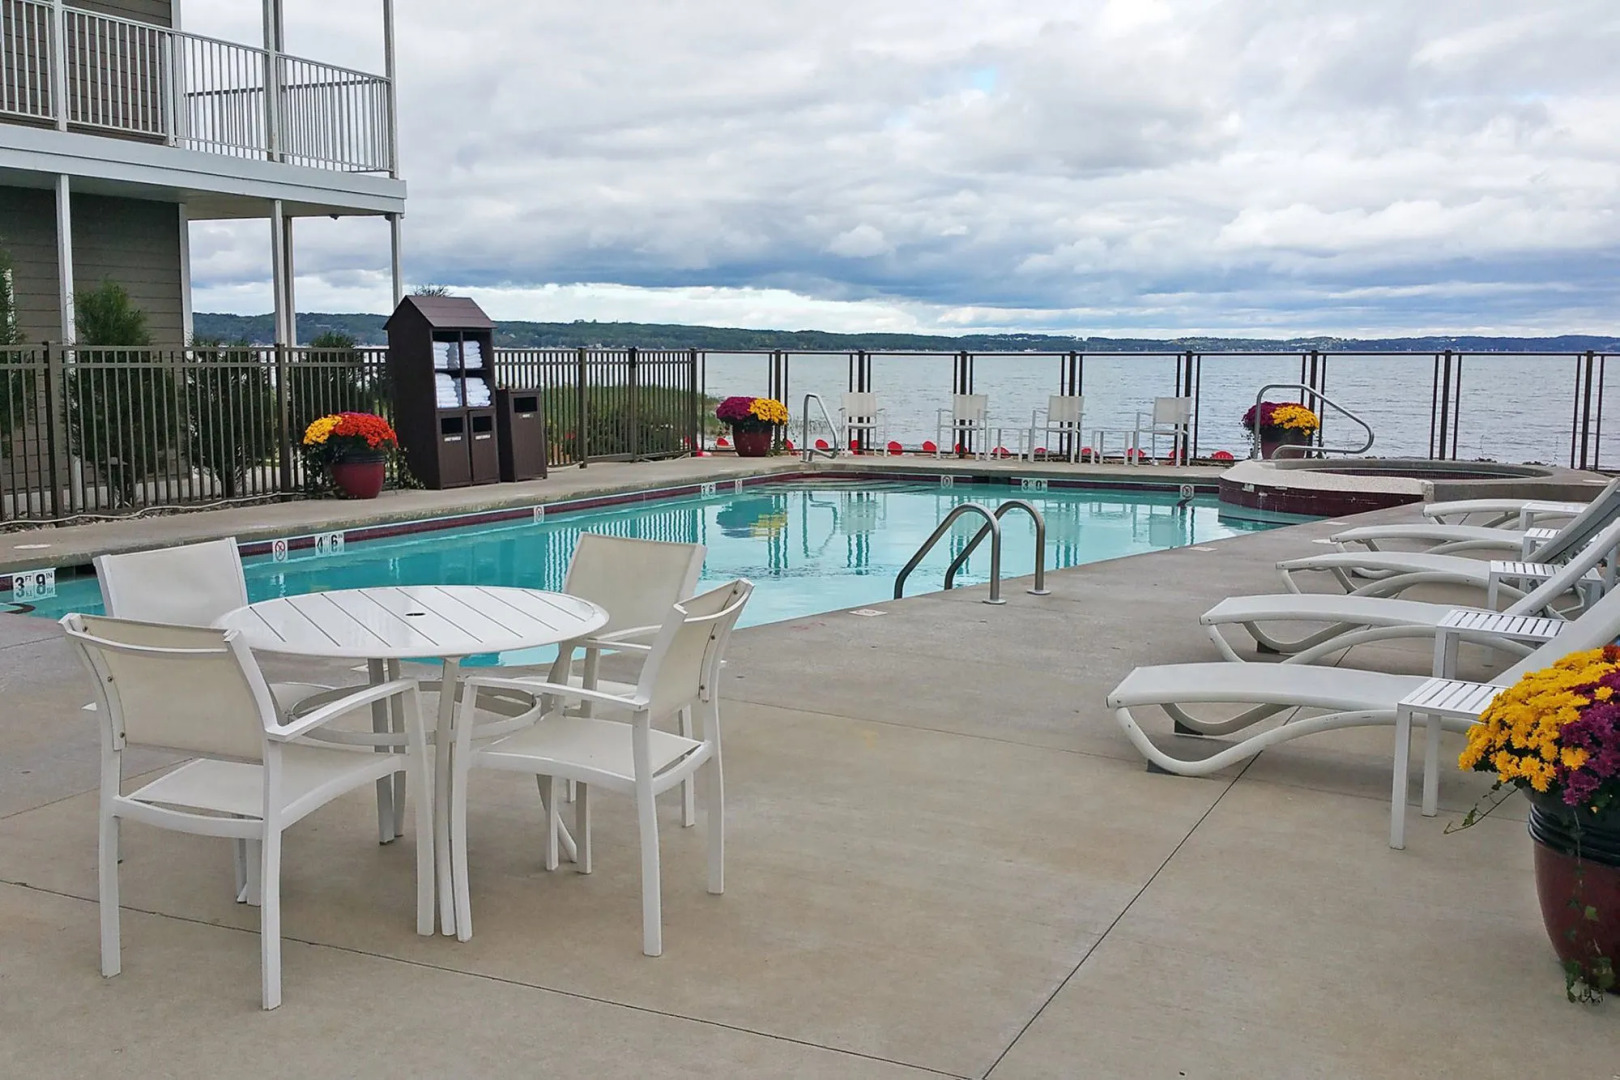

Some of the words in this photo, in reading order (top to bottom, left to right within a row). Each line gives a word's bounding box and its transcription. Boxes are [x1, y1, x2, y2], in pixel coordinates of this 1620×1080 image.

[331, 534, 338, 547] 6
[15, 576, 25, 591] 3
[36, 573, 46, 586] 9
[46, 571, 53, 579] IN
